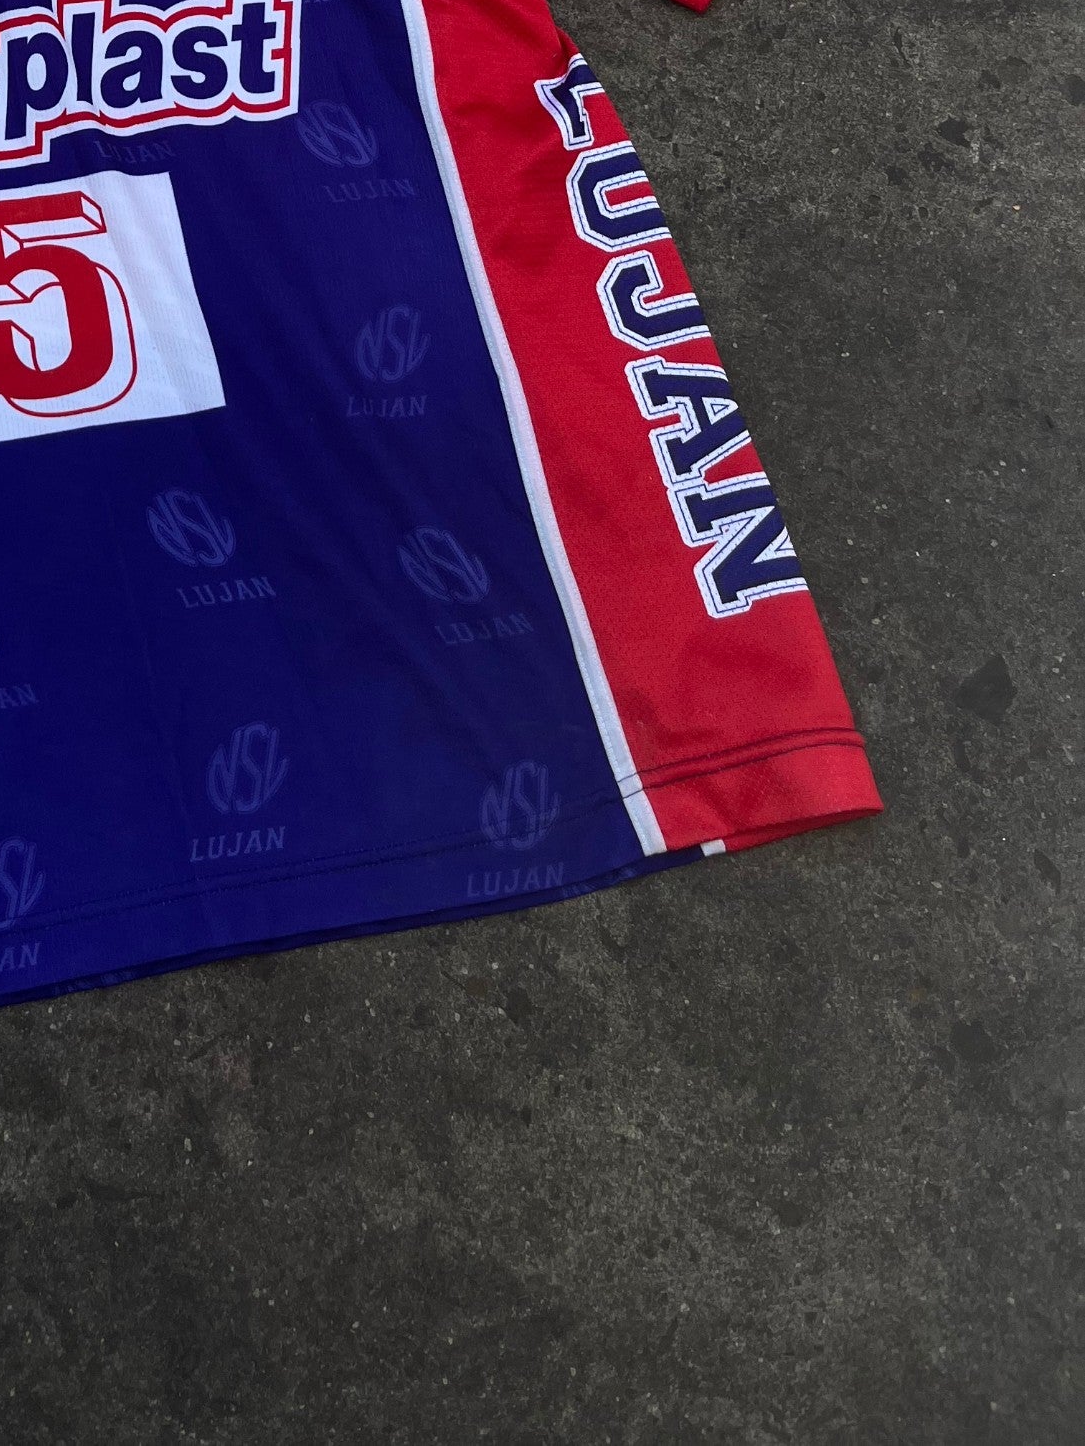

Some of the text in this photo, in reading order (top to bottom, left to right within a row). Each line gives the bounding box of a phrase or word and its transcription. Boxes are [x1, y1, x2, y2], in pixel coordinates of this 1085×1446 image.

[323, 177, 417, 204] LUJAN
[345, 393, 428, 418] LUJAN
[176, 575, 278, 610] LUJAN
[433, 612, 535, 646] LUJAN
[188, 825, 287, 863] LUJAN
[465, 862, 566, 898] LUJAN
